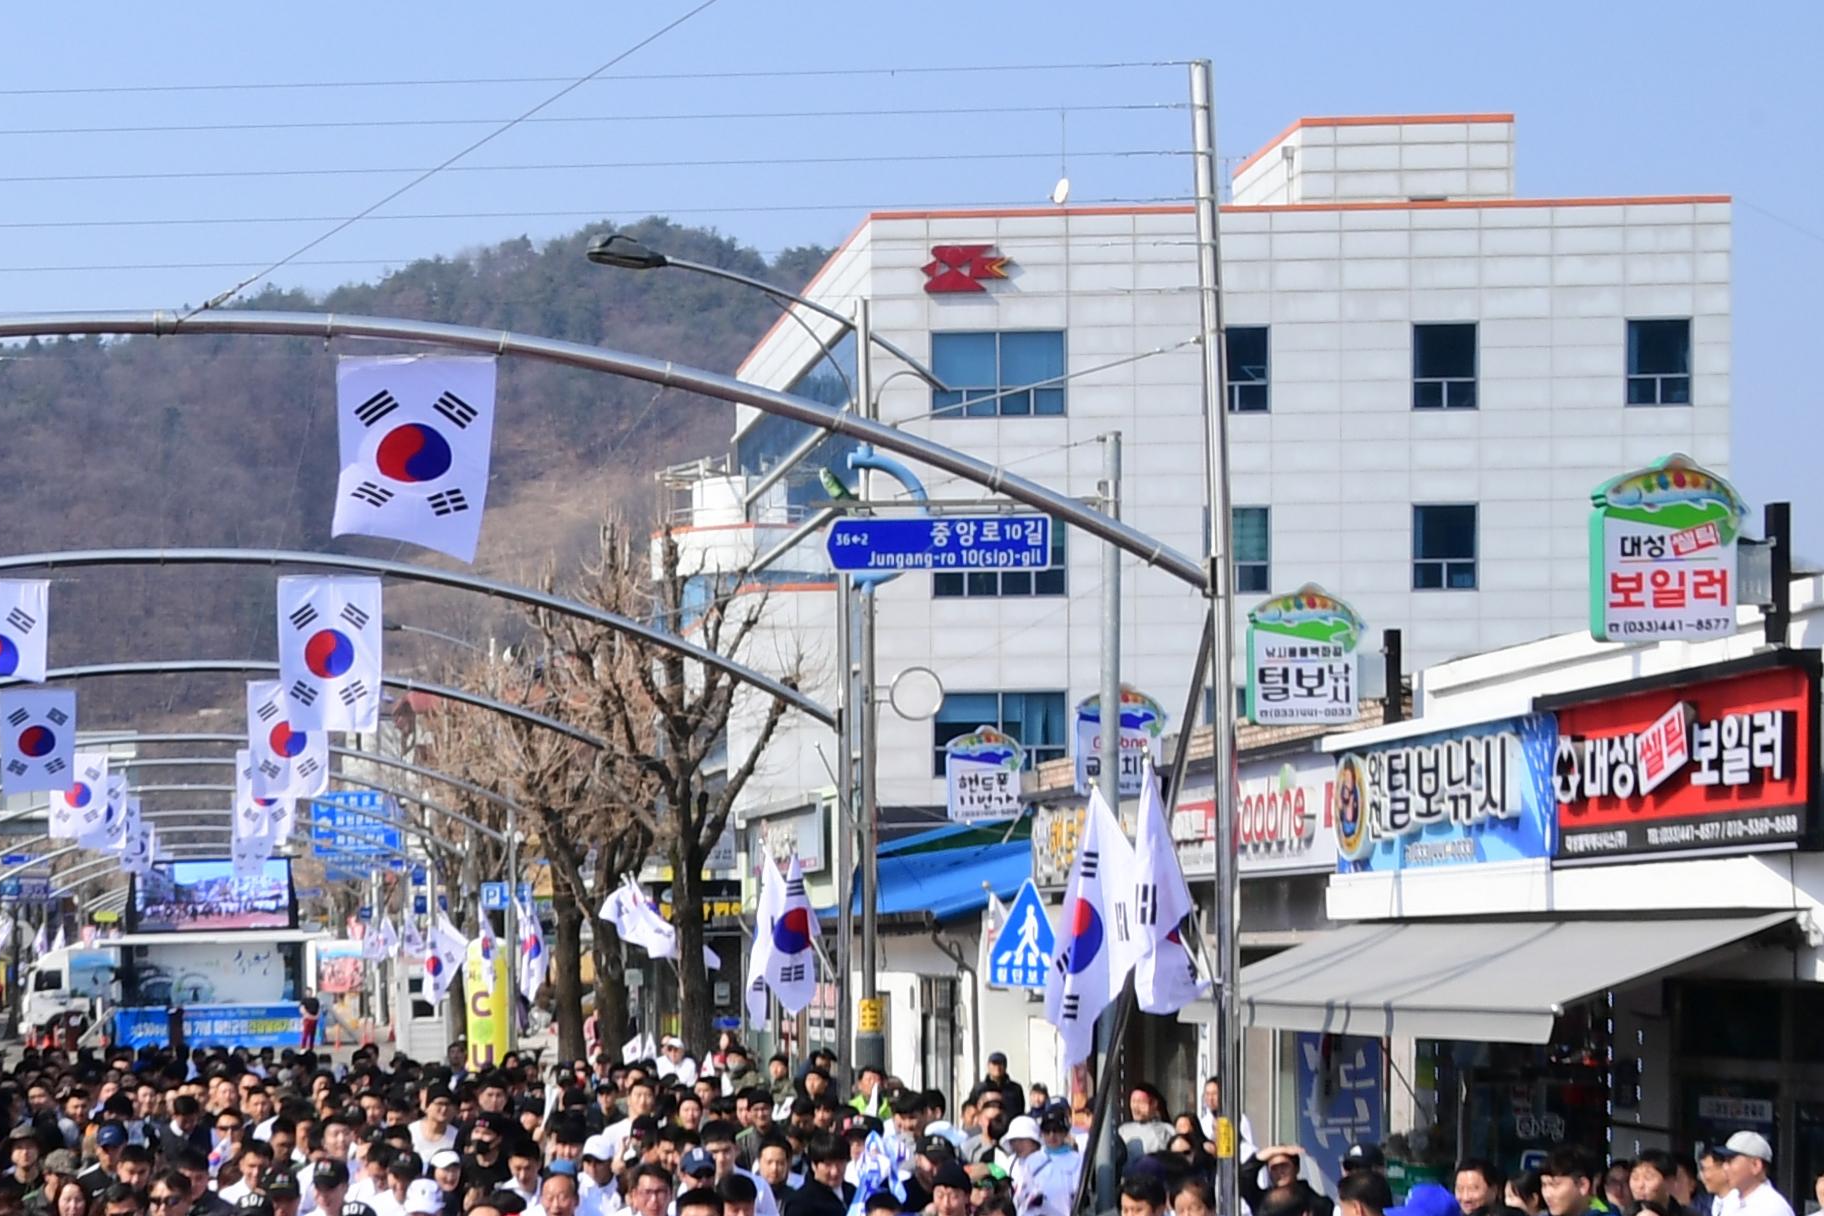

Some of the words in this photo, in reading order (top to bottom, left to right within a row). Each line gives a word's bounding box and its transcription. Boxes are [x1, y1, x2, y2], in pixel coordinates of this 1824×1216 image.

[867, 550, 956, 569] Jungang-ro
[1620, 535, 1666, 558] 대성
[1608, 569, 1729, 609] 보일러
[1584, 733, 1634, 800] 대성
[1690, 710, 1782, 786] 보일러
